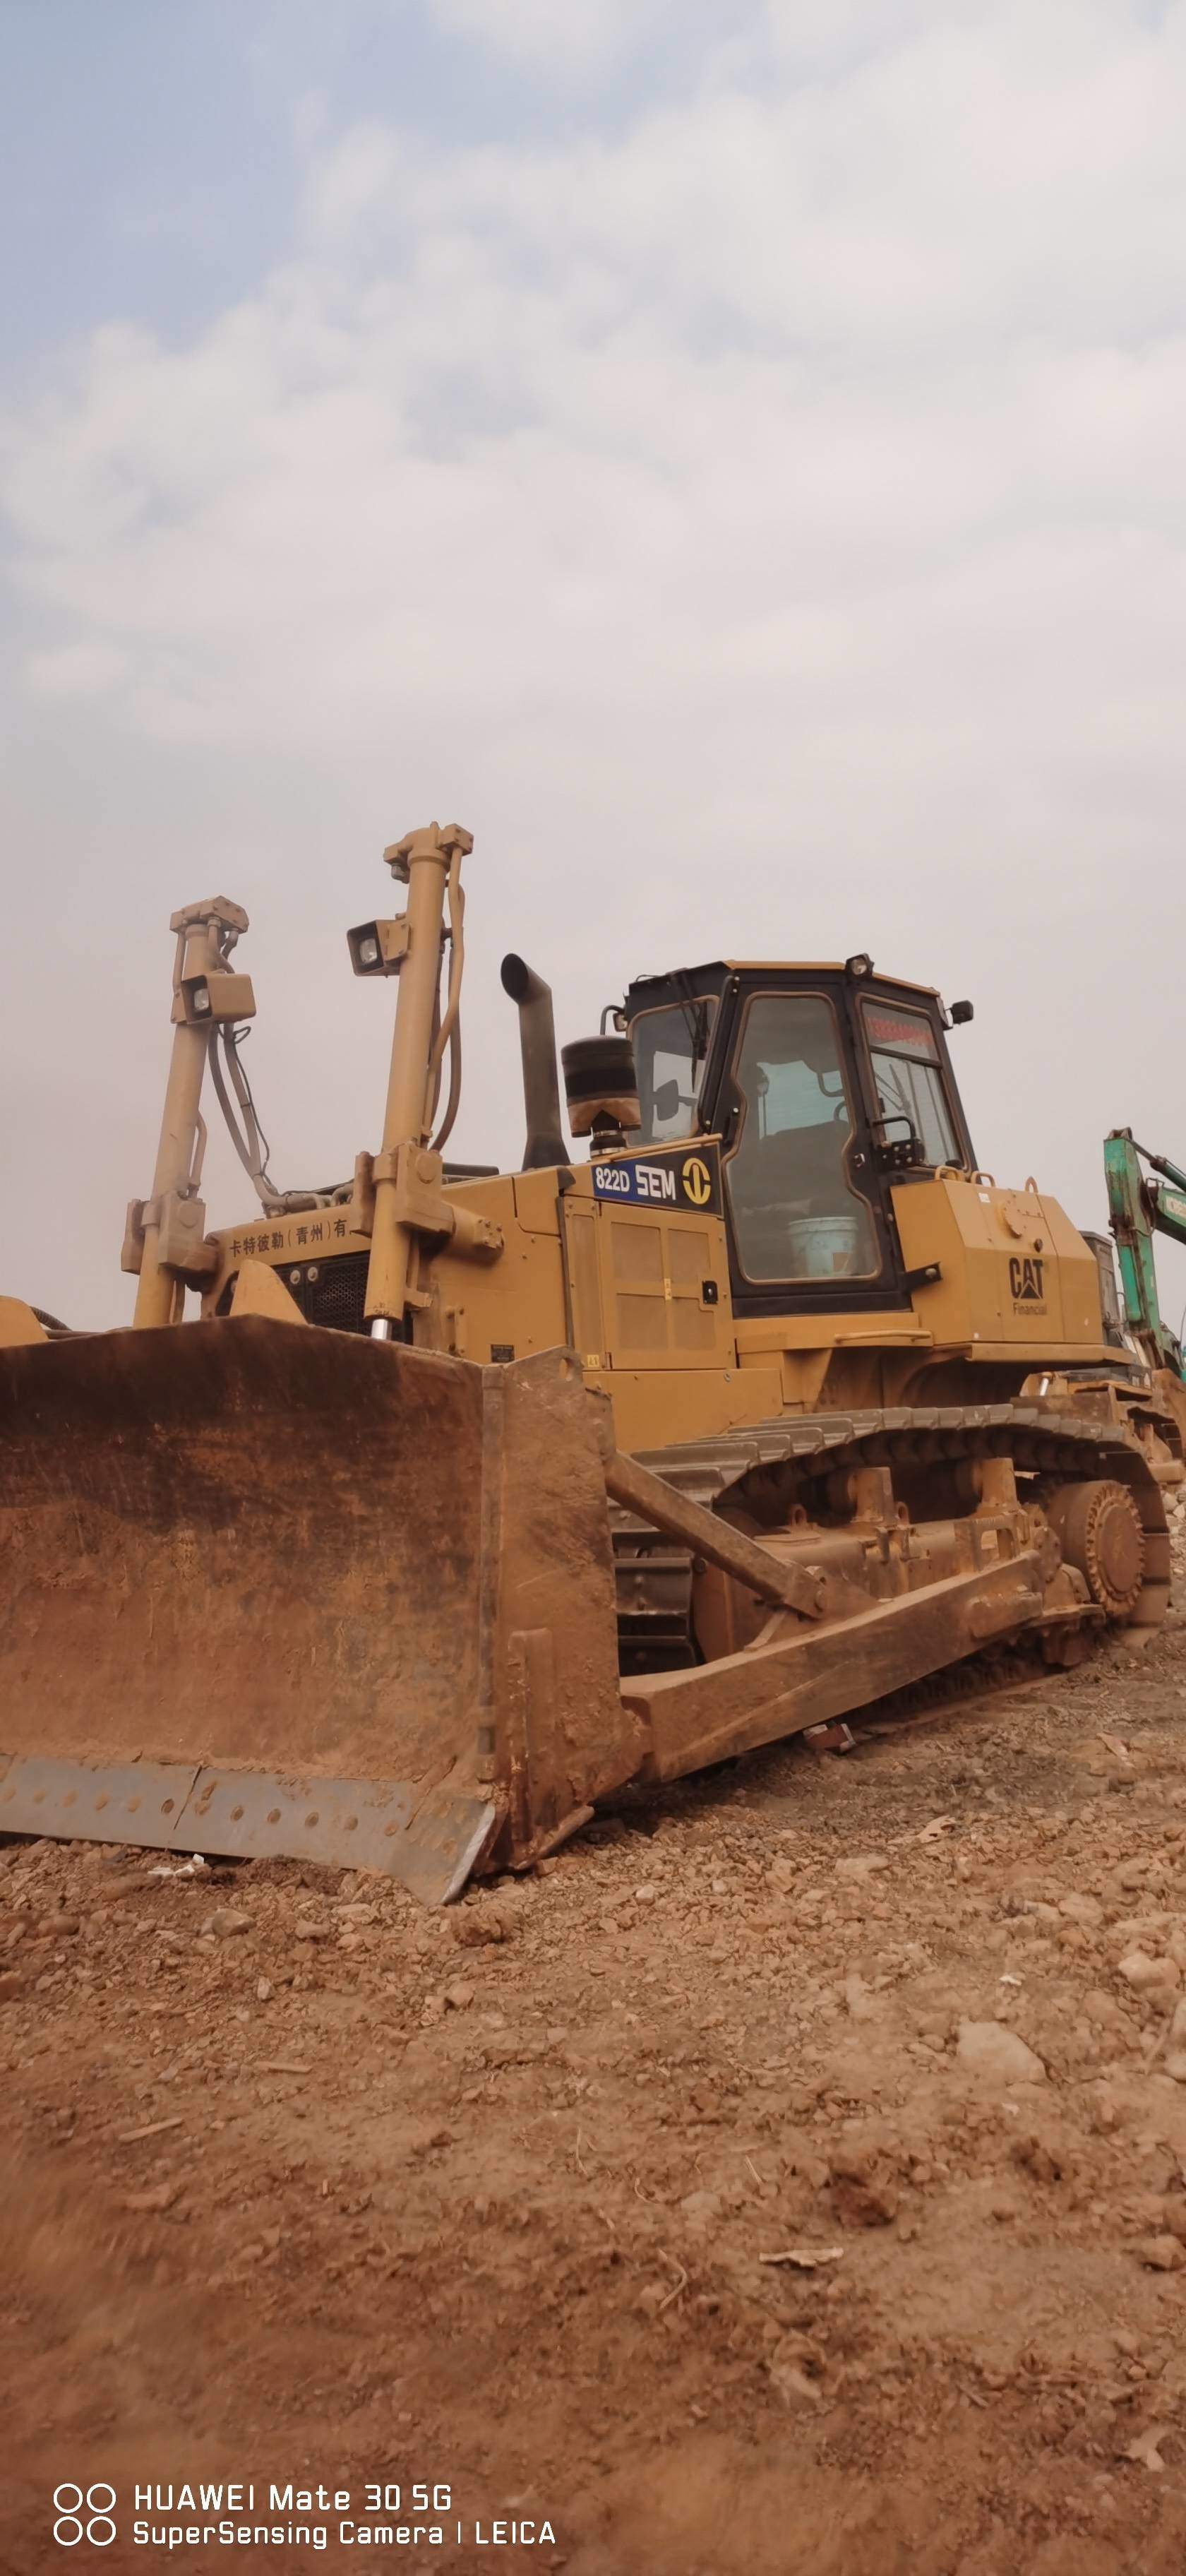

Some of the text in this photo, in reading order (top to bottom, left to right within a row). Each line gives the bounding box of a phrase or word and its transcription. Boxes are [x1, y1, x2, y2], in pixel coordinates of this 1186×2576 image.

[595, 1164, 676, 1200] 822D SEM
[229, 1219, 353, 1258] 卡特彼勒（青州）有
[1009, 1257, 1043, 1299] CAT
